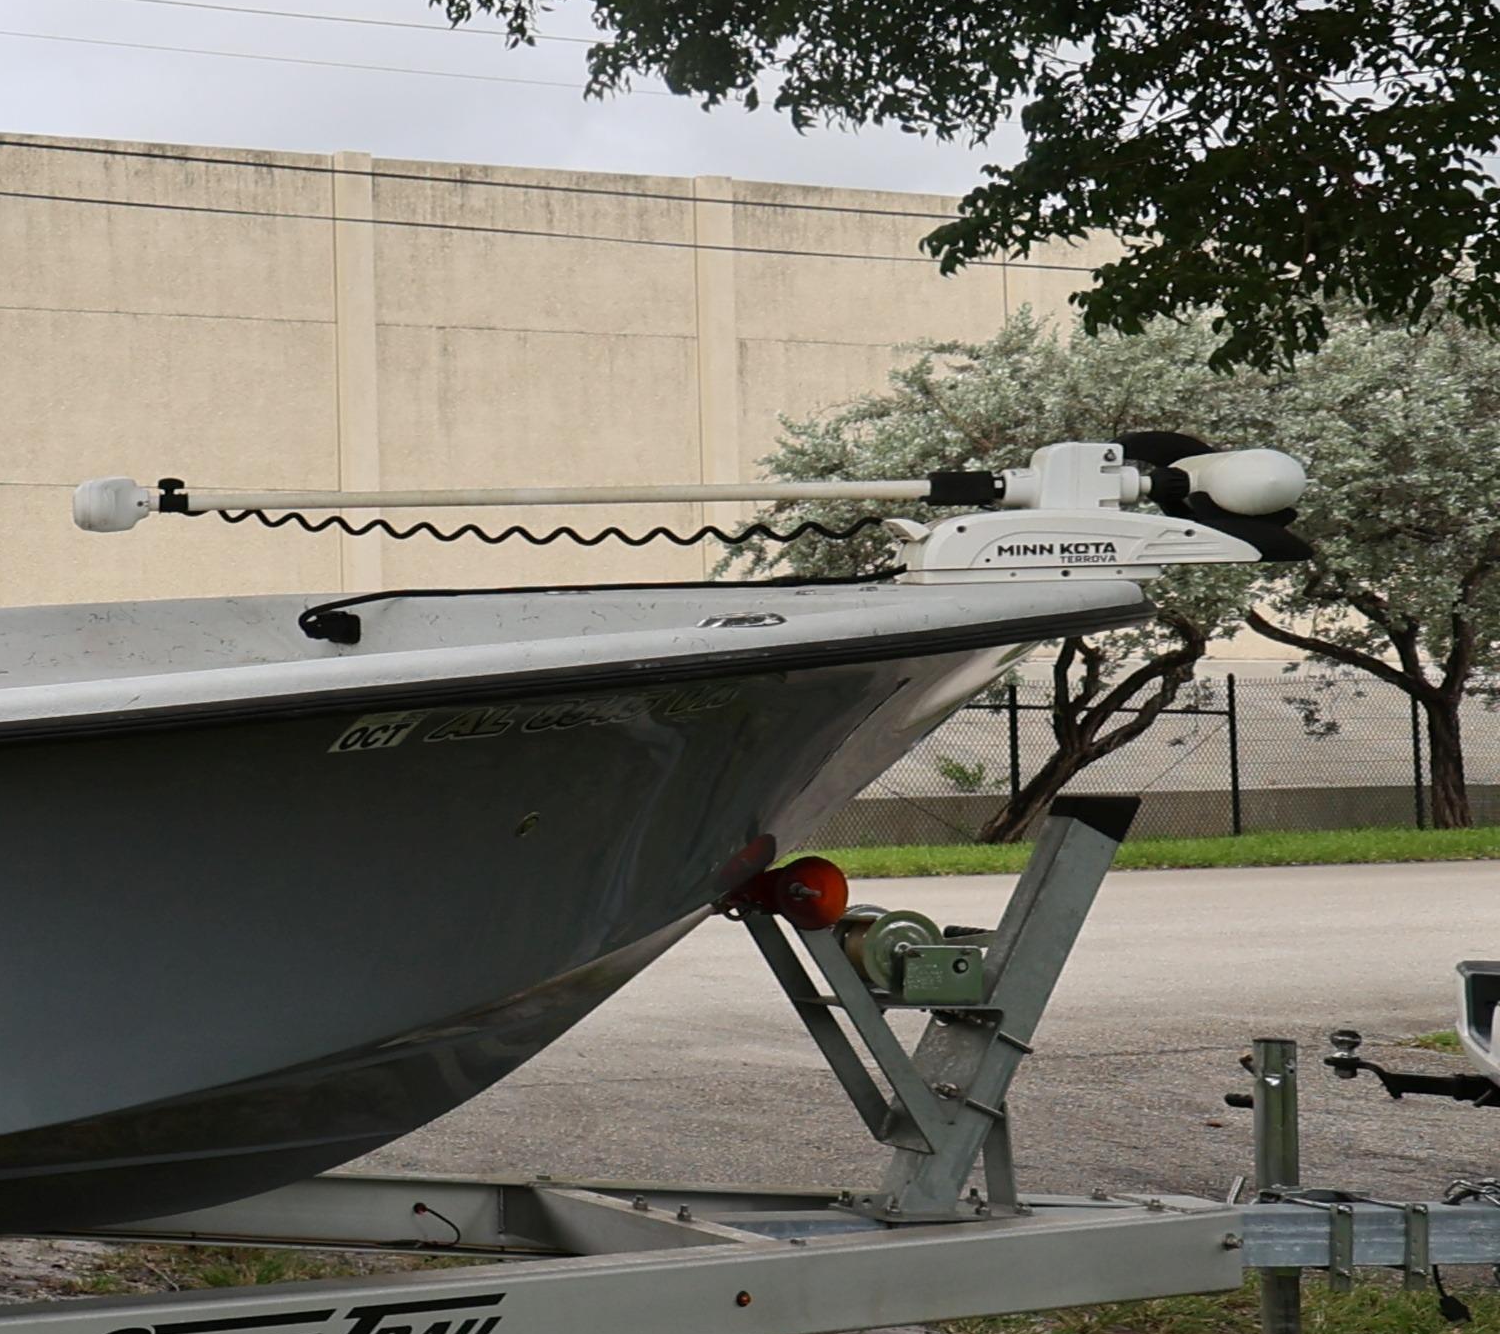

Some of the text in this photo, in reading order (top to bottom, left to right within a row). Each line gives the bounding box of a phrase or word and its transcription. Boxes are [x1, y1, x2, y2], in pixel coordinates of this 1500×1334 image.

[997, 542, 1116, 556] MINN KOTA
[1059, 555, 1116, 563] TERROVA
[338, 722, 414, 750] OCT
